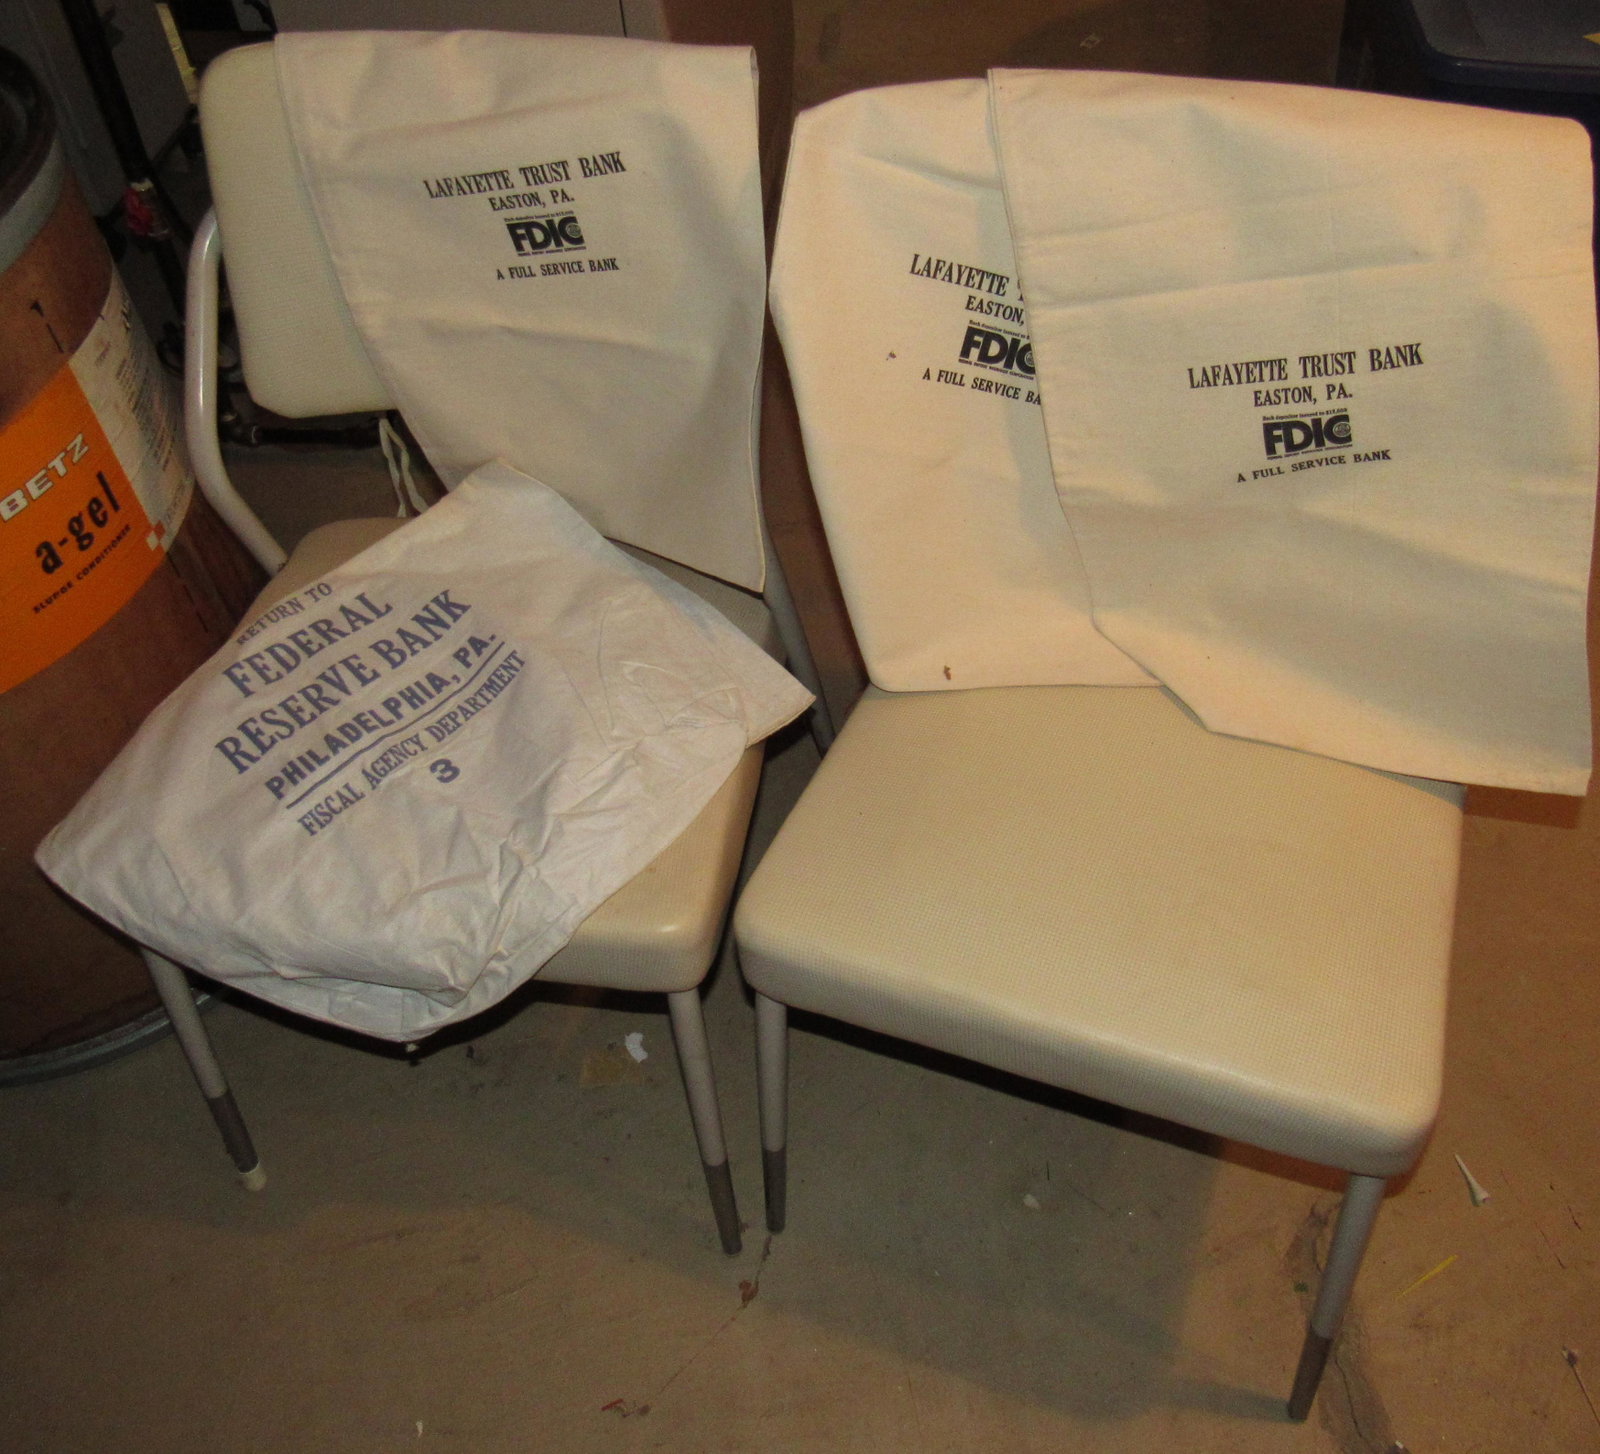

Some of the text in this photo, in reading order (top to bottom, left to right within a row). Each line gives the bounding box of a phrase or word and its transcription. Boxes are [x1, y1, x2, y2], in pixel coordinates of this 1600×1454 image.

[424, 151, 626, 199] LAFAYETTE TRUST BANK
[488, 188, 575, 212] EASTON, PA.
[506, 216, 585, 252] FDIC
[496, 257, 619, 281] A FULL SERVICE BANK
[909, 253, 1010, 297] LAFAYETTE
[965, 295, 1025, 326] EASTON,
[960, 326, 1036, 375] FDIC
[1188, 343, 1424, 389] LAFAYETTE TRUST BANK
[922, 368, 931, 380] A
[936, 369, 965, 387] FULL
[971, 377, 1021, 400] SERVICE
[1025, 390, 1041, 406] BA
[1253, 382, 1353, 408] EASTON, PA.
[1263, 414, 1352, 456] FDIC
[0, 433, 89, 522] BETZ
[1236, 473, 1246, 483] A
[1252, 466, 1285, 480] FULL
[1291, 455, 1347, 472] SERVICE
[1353, 449, 1392, 464] BANK
[36, 470, 121, 575] a-gel
[236, 582, 333, 646] RETURN TO
[222, 592, 393, 698] FEDERAL
[214, 588, 472, 775] RESERVE BANK
[264, 634, 497, 800] PHILADELPHIA, PA.
[297, 649, 526, 837] FISCAL AGENCY DEPARTMENT
[429, 758, 461, 783] 3
